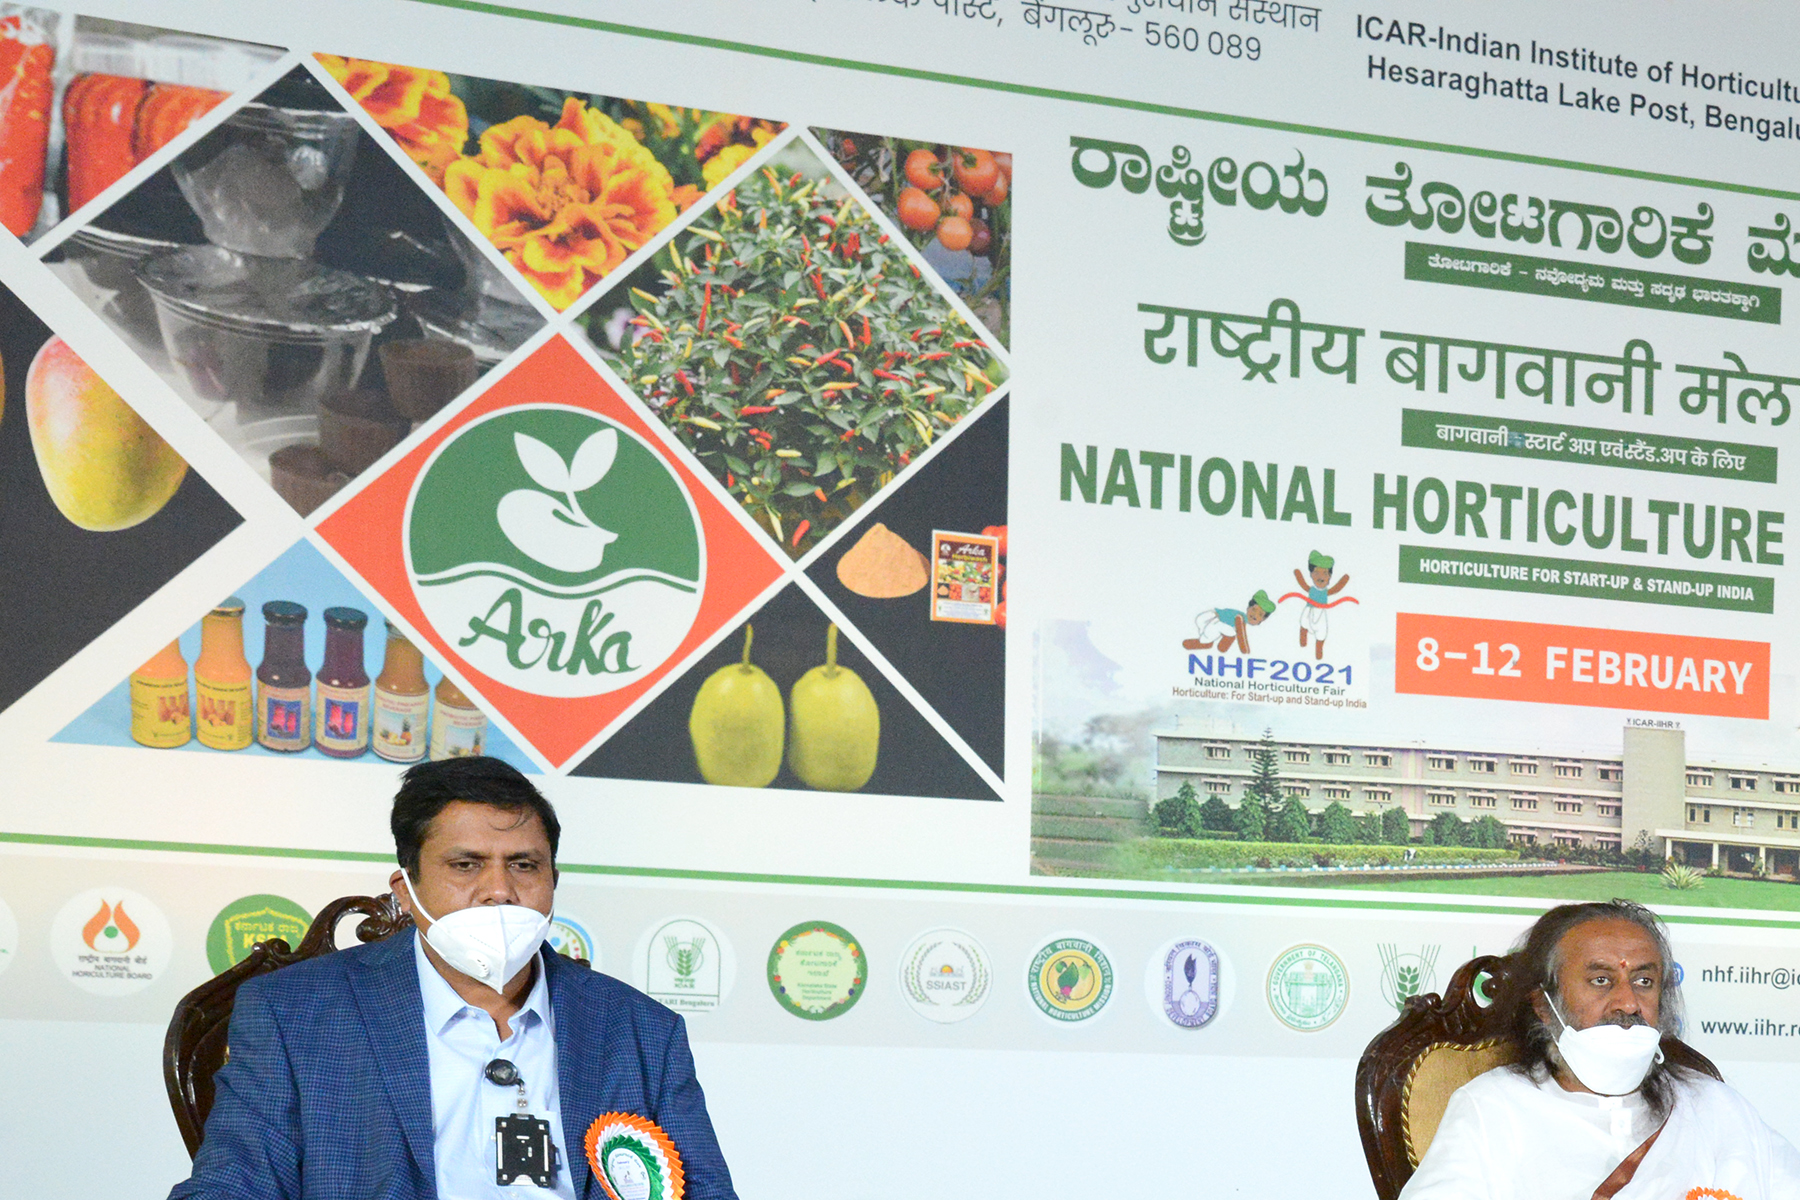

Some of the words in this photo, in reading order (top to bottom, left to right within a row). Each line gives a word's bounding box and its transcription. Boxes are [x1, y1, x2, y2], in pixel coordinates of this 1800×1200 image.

[1145, 21, 1199, 53] 560
[1207, 30, 1261, 61] 089
[1356, 14, 1520, 61] ICAR-Indian
[1531, 40, 1638, 79] Institute
[1647, 61, 1674, 84] of
[1367, 54, 1548, 103] Hesaraghatta
[1558, 82, 1621, 114] Lake
[1630, 93, 1695, 128] Post,
[1069, 135, 1329, 247] ರಾಷ್ಟ್ರೀಯ
[1364, 160, 1715, 266] ತೋಟಗಾರಿಕೆ
[1137, 297, 1365, 384] राष्ट्रीय
[1380, 330, 1662, 416] बागवानी
[1435, 424, 1509, 447] बागवानी
[1524, 432, 1567, 452] स्टार्ट
[1690, 446, 1709, 467] के
[1711, 448, 1746, 471] लिए
[1060, 442, 1352, 527] NATIONAL
[1373, 471, 1785, 566] HORTICULTURE
[1420, 557, 1528, 581] HORTICULTURE
[1532, 567, 1560, 583] FOR
[1563, 570, 1629, 590] START-UP
[1633, 576, 1643, 591] &
[1647, 578, 1714, 598] STAND-UP
[1717, 583, 1755, 601] INDIA
[458, 587, 642, 676] Arka
[1188, 653, 1353, 686] NHF2021
[1194, 676, 1245, 690] National
[1248, 679, 1320, 695] Horticulture
[1322, 685, 1346, 697] Fair
[1545, 645, 1753, 696] FEBRUARY
[1172, 686, 1229, 701] Horticulture:
[1230, 690, 1247, 701] For
[1248, 691, 1285, 706] Start-up
[1285, 694, 1302, 705] and
[1304, 695, 1344, 709] Stand-up
[1345, 697, 1368, 709] India
[1632, 718, 1674, 729] ICAR-IIHR
[926, 980, 967, 991] SSIAST
[1272, 950, 1304, 986] GOVERNMENT
[1320, 953, 1344, 987] TELANGANA
